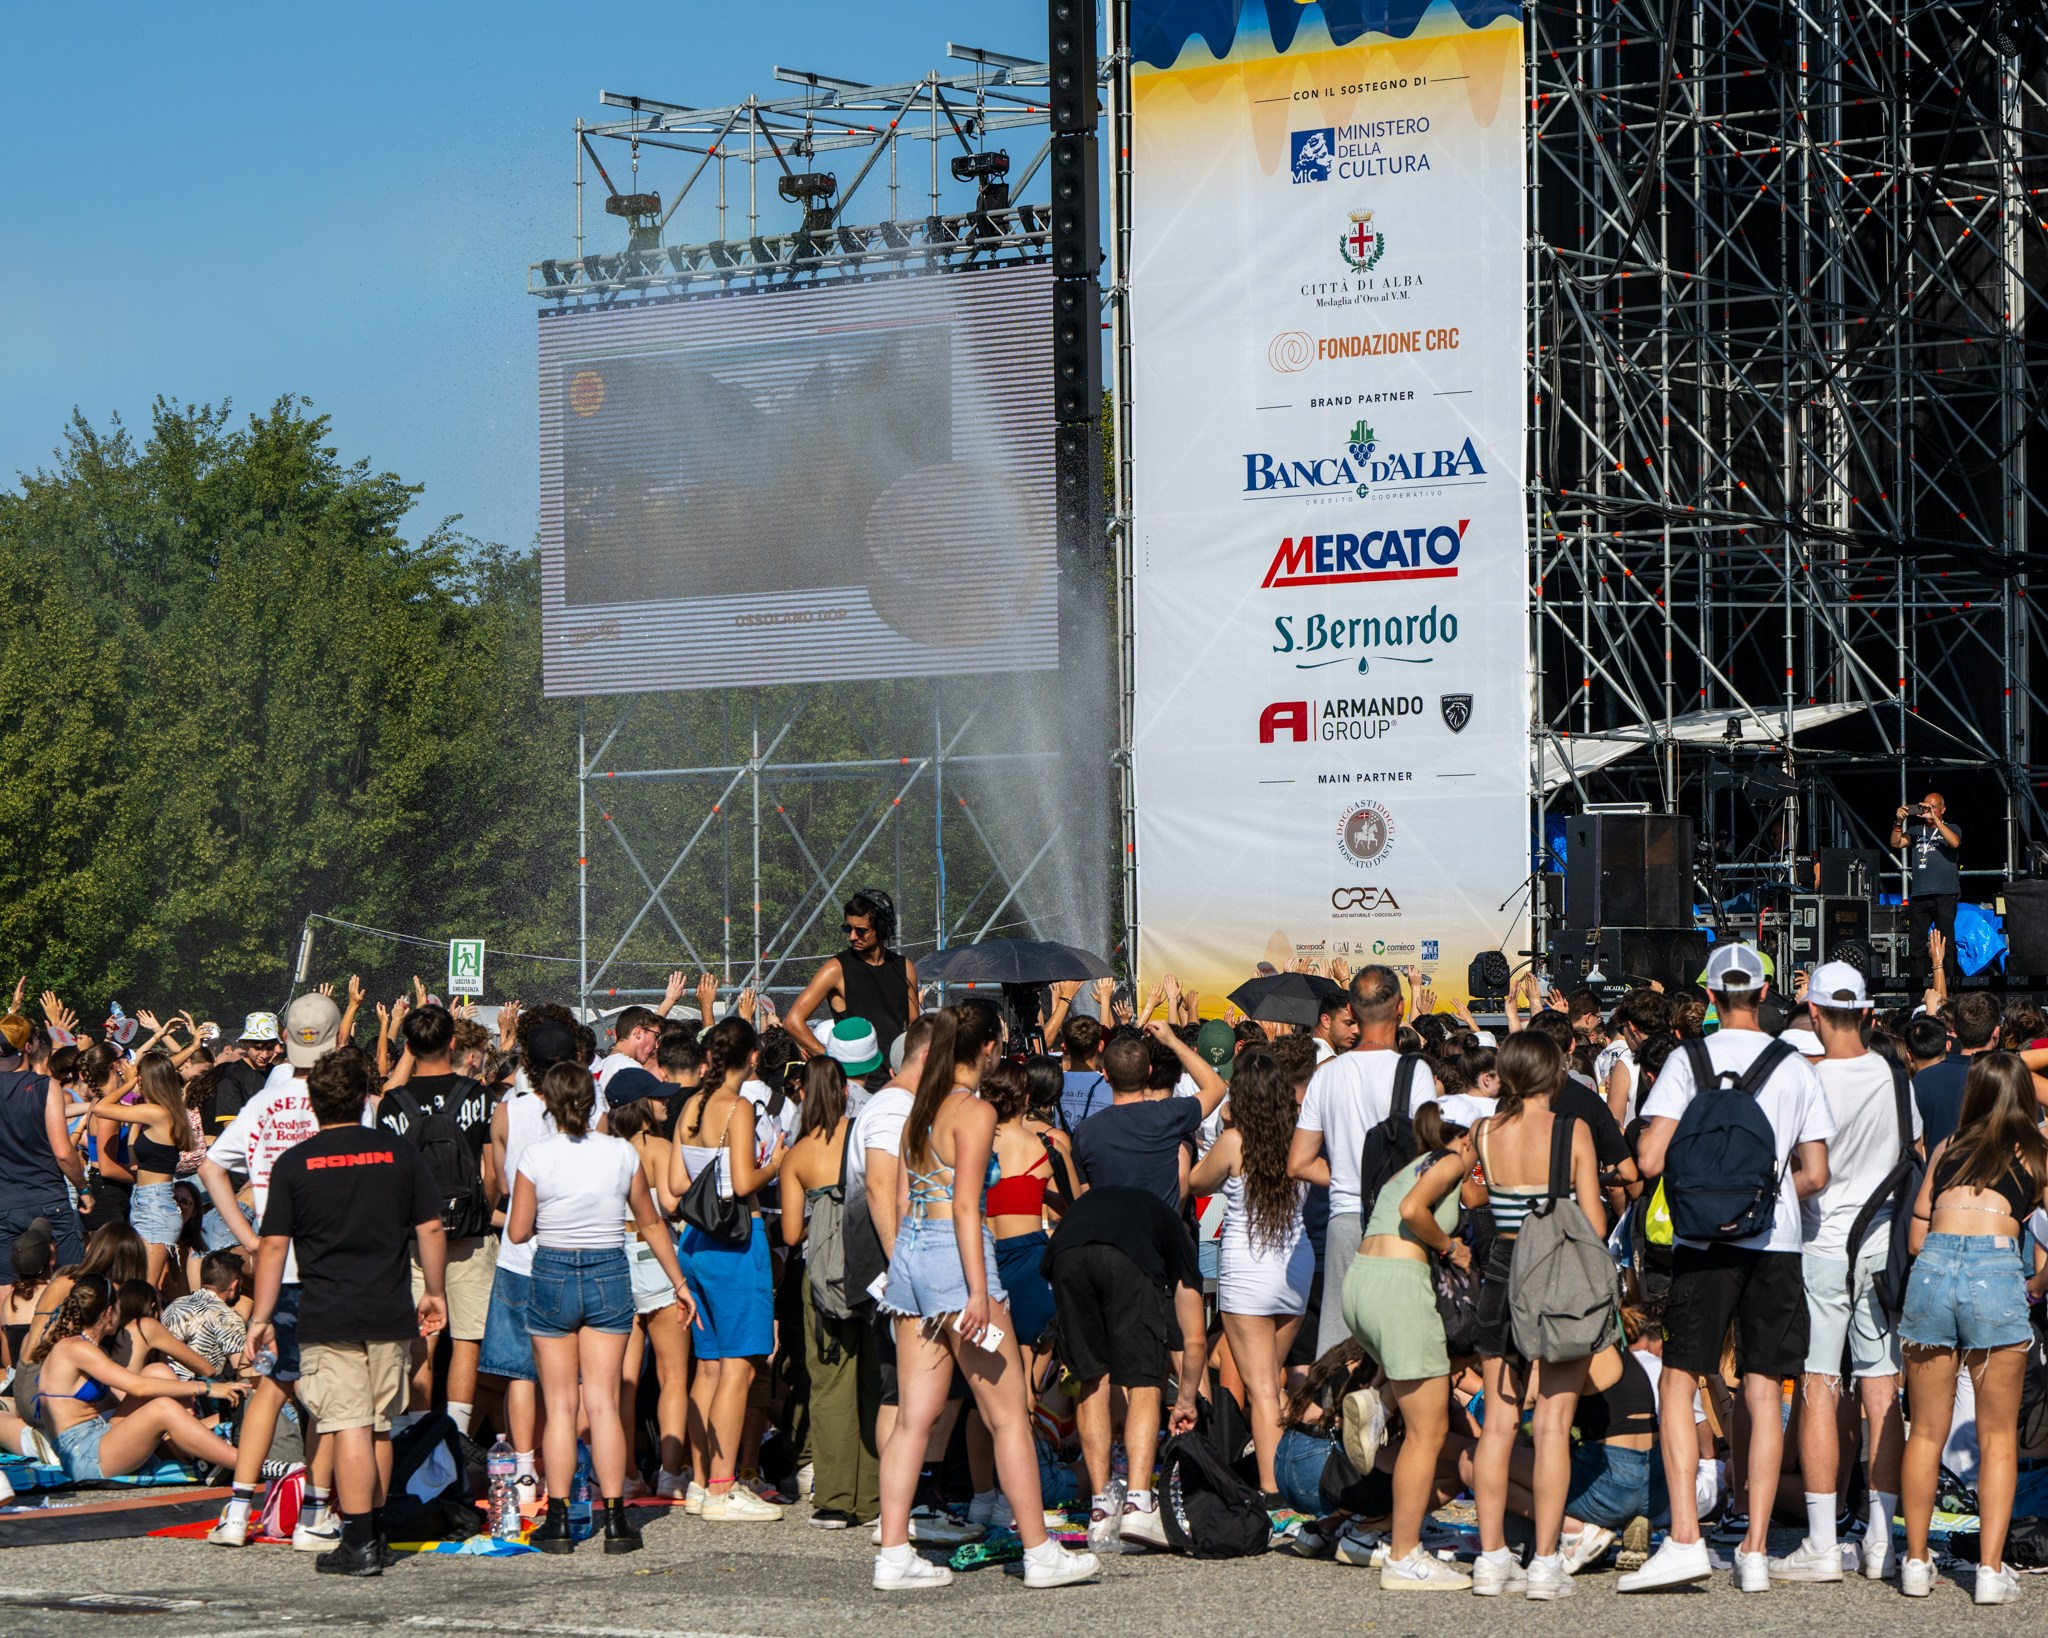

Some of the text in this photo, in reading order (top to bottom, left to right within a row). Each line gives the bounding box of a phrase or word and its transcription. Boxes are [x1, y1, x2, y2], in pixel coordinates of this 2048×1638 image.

[1293, 76, 1427, 101] CON IL SOSTEGNO DI
[1338, 116, 1430, 142] MINISTERO
[1338, 142, 1381, 158] DELLA
[1291, 168, 1318, 184] MiC
[1338, 154, 1431, 179] CULTURA
[1301, 274, 1423, 296] CITTÀ DI ALBA
[1316, 290, 1411, 308] Medaglia d'Oro al V.M.
[1318, 327, 1460, 360] FONDAZIONE CRC
[1310, 390, 1414, 408] BRAND PARTNER
[1242, 453, 1358, 492] BANCA
[1305, 490, 1443, 506] CREDITO COOPERATIVO
[1322, 695, 1423, 719] ARMANDO
[1317, 771, 1413, 784] MAIN PARTNER
[1331, 886, 1400, 911] CREA
[1387, 941, 1416, 952] comieco
[306, 1150, 394, 1171] RONIN
